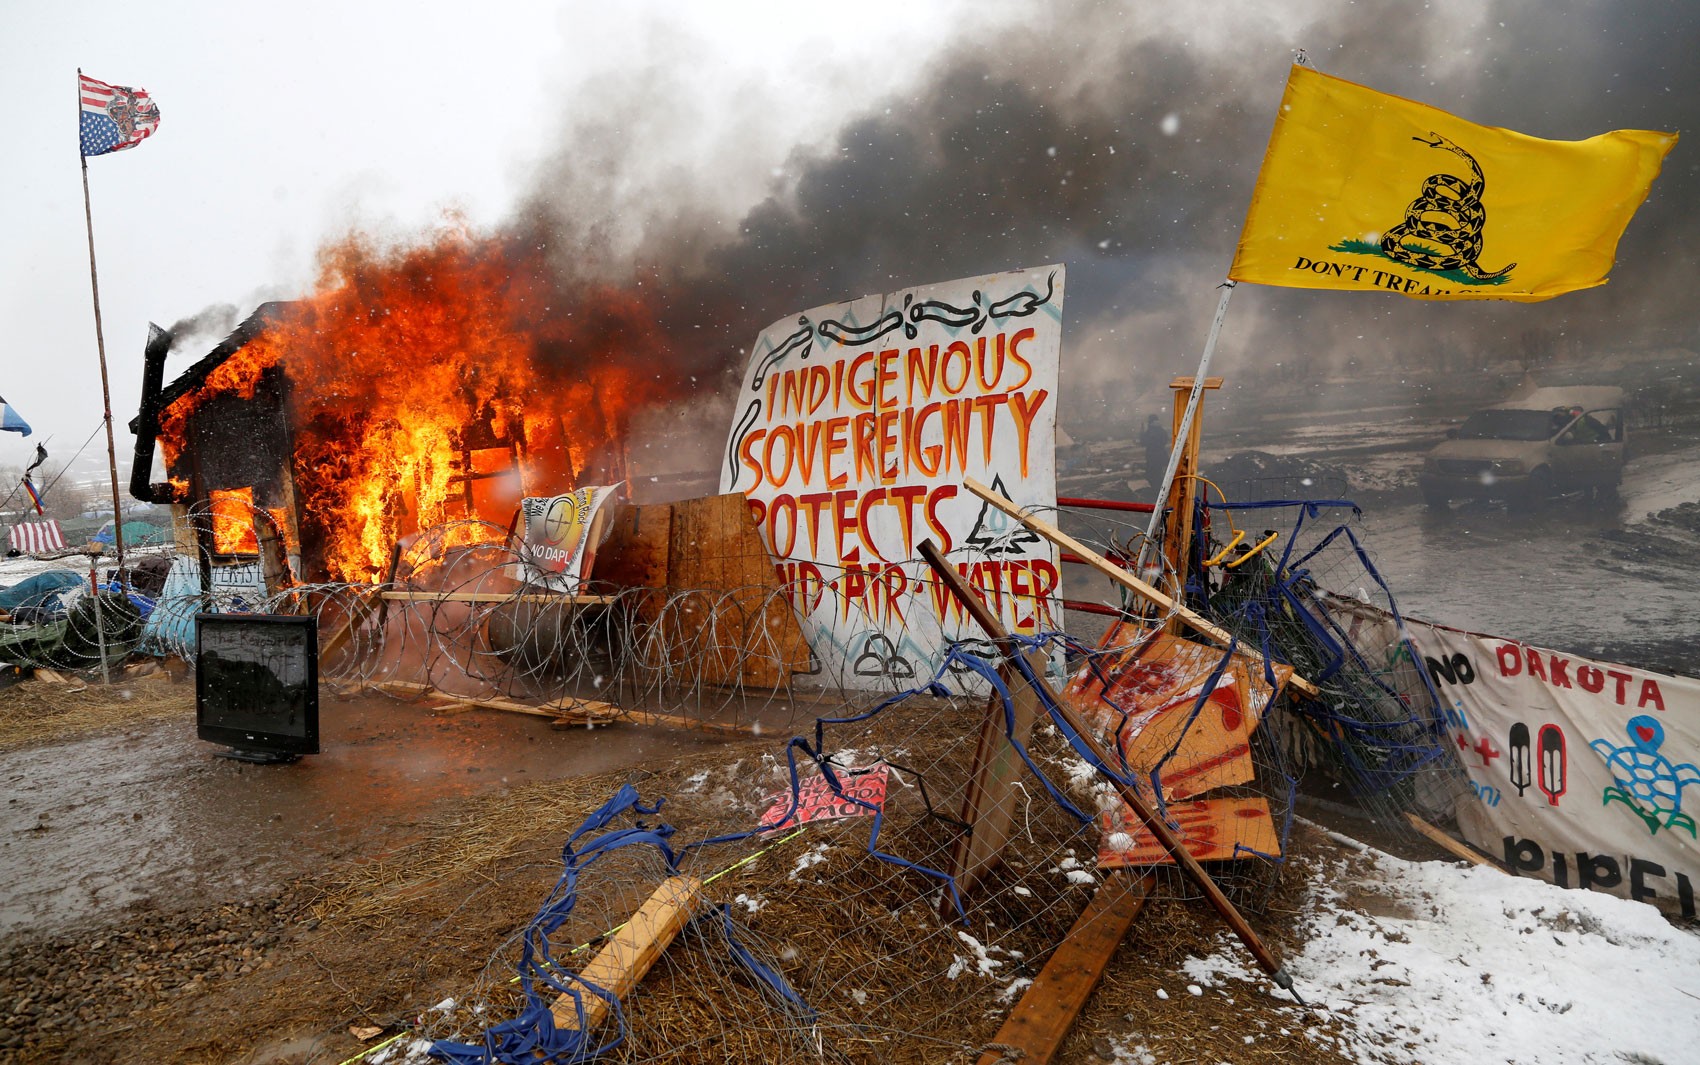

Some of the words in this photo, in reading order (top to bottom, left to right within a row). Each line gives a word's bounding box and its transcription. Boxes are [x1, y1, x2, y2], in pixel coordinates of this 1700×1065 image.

[1294, 256, 1369, 282] DON'T
[1373, 269, 1449, 295] TREA
[766, 327, 1035, 422] INDIGENOUS
[739, 389, 1048, 497] SOVEREIGNTY
[577, 505, 590, 525] Rock
[531, 543, 545, 558] NO
[545, 547, 570, 565] DAPL
[1425, 653, 1475, 688] NO
[1495, 643, 1666, 712] DAKOTA
